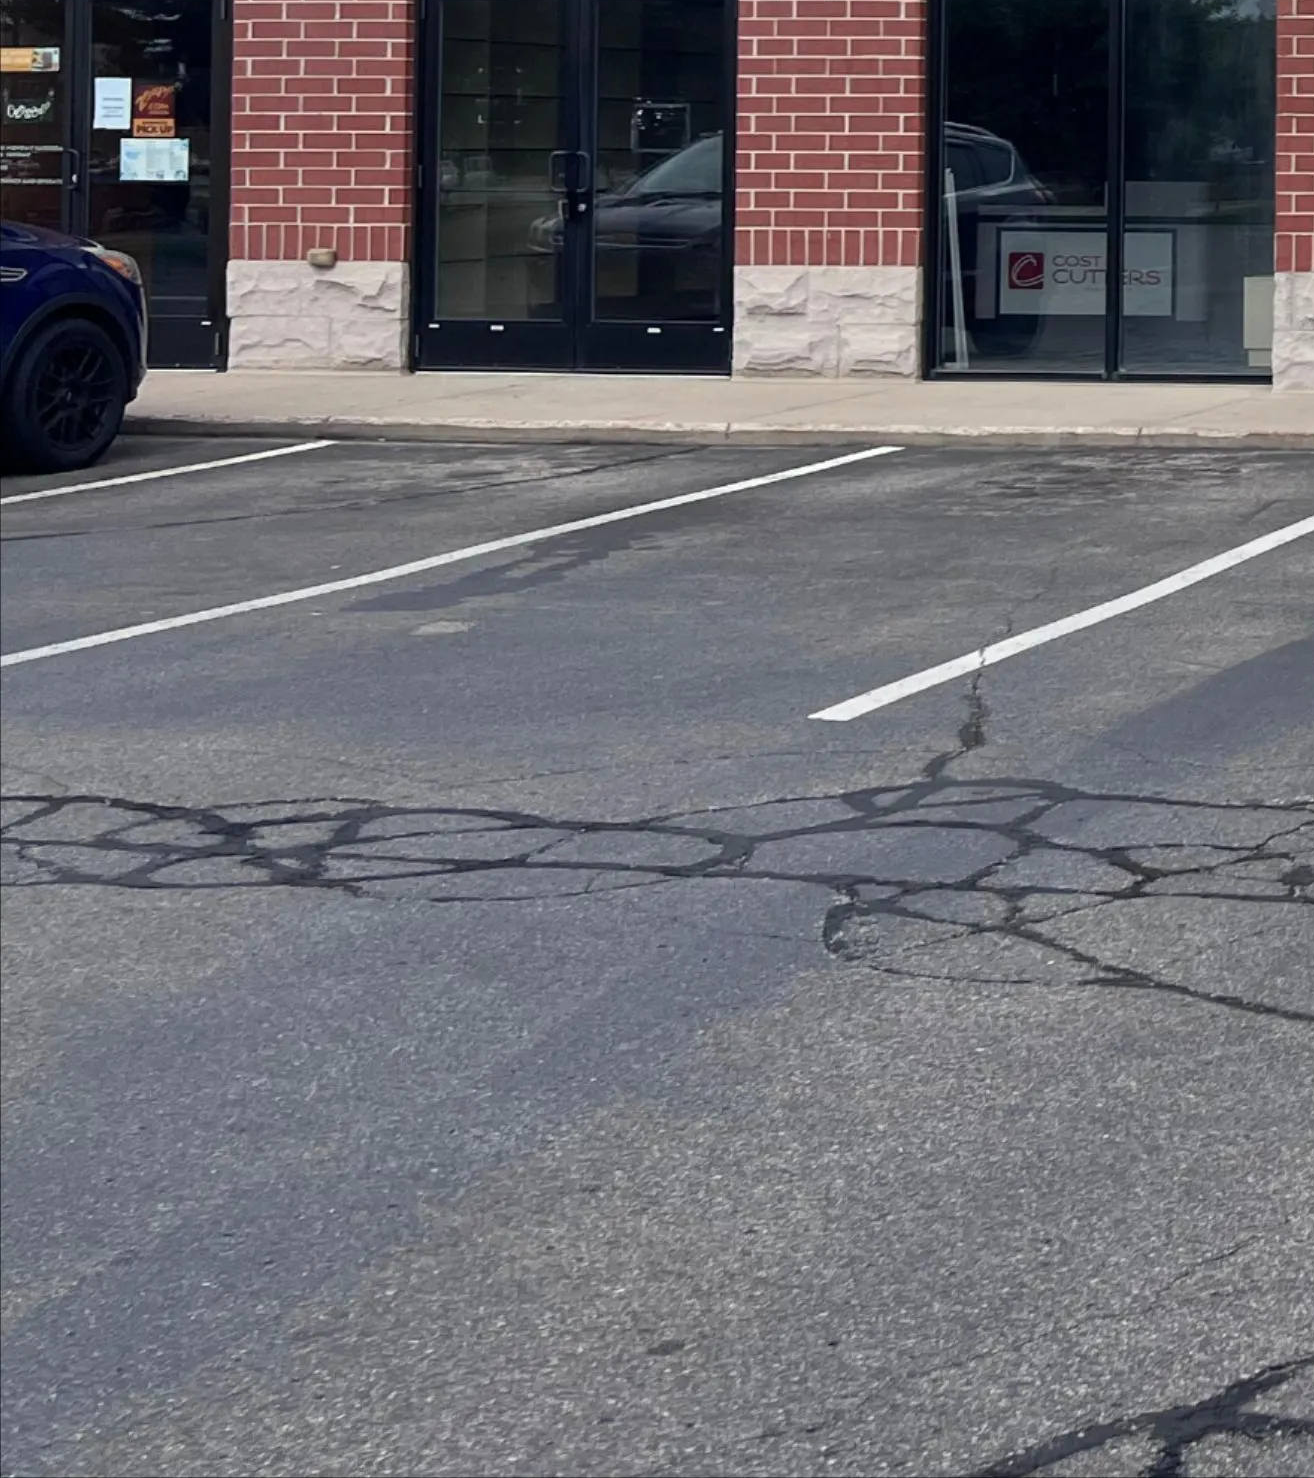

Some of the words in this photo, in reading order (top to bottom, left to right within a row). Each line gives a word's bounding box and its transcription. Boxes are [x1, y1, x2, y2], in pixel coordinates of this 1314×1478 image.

[136, 124, 158, 133] PICK
[160, 124, 173, 133] UP
[1052, 255, 1103, 268] COST
[1052, 269, 1161, 285] CUTERS
